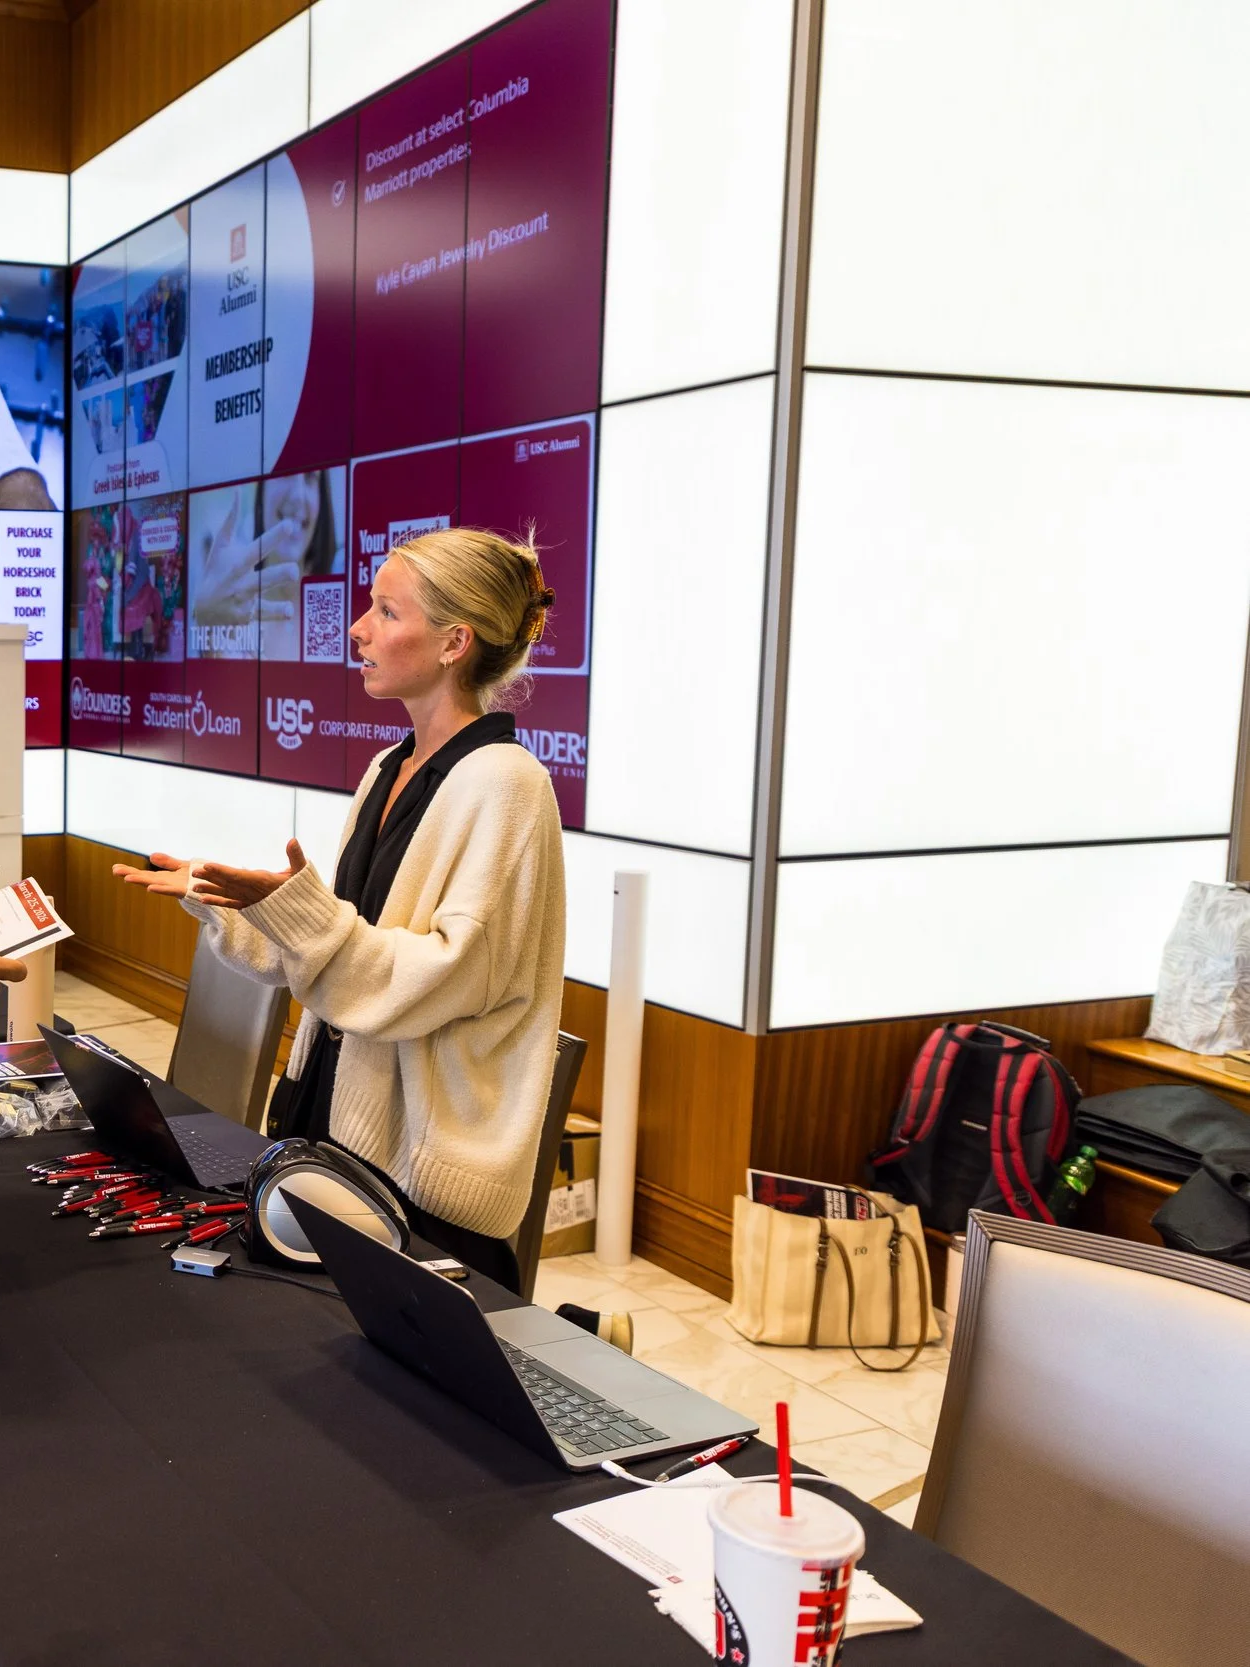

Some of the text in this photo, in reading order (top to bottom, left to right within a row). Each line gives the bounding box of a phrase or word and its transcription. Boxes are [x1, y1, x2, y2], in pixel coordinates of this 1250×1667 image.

[365, 75, 529, 172] Discount at select Columbia
[365, 141, 471, 203] Marriott properties
[376, 211, 549, 295] Kyle Cavan Jewelry Discount
[227, 265, 250, 291] USC
[219, 284, 257, 316] Alumni
[205, 337, 274, 382] MEMBERSHIP
[215, 388, 261, 424] BENEFITS
[530, 435, 580, 455] USC Alumni
[134, 470, 160, 490] Ephesus
[7, 527, 53, 538] PURCHASE
[359, 529, 387, 554] Your
[17, 547, 41, 558] YOUR
[3, 566, 57, 578] HORSESHOE
[358, 561, 369, 586] is
[15, 586, 42, 598] BRICK
[14, 606, 46, 618] TODAY!
[27, 630, 44, 642] SC
[190, 626, 210, 651] THE
[212, 625, 235, 651] USC
[83, 687, 131, 717] FOUNDES
[143, 703, 241, 736] Student Loan
[266, 697, 314, 734] USC
[319, 719, 372, 739] CORPORATE
[28, 897, 40, 911] 25,
[32, 906, 49, 923] 2026
